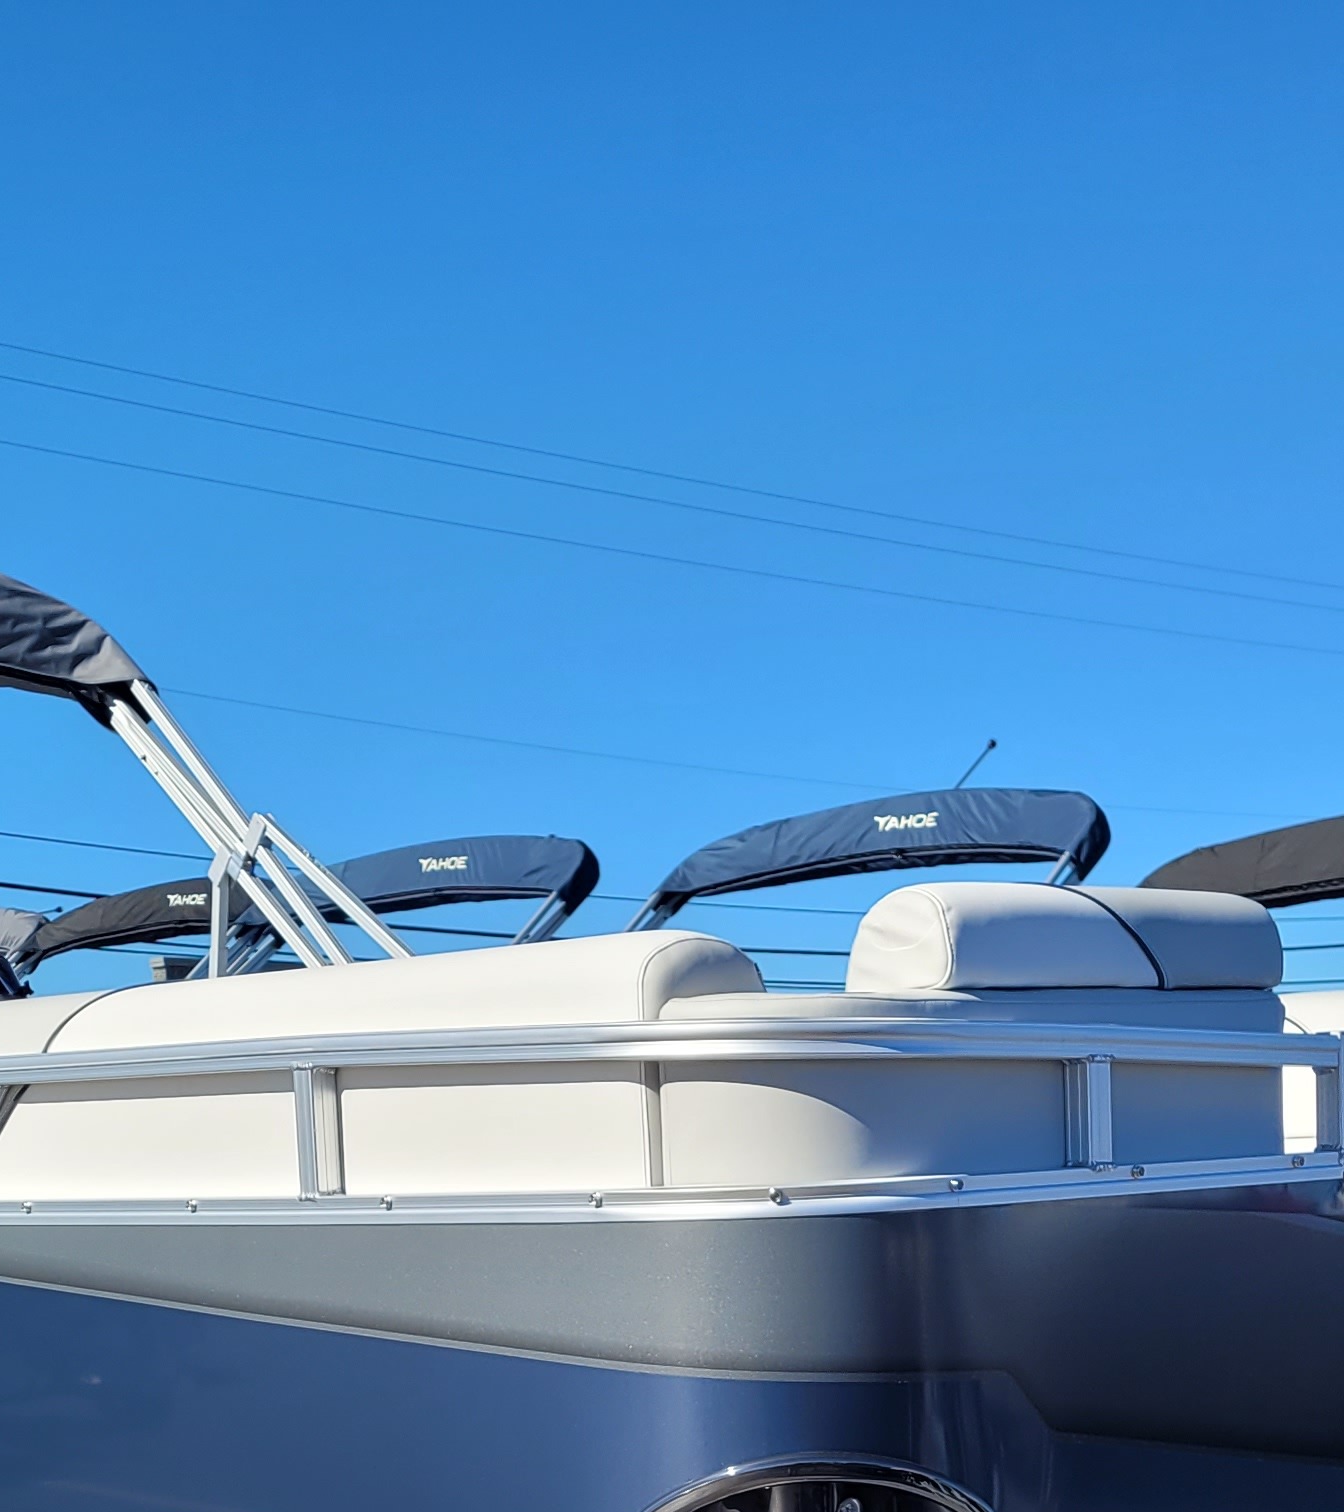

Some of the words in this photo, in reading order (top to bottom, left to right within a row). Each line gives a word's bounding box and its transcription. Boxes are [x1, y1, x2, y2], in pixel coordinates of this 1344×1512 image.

[873, 811, 940, 833] TAHOE
[418, 855, 469, 874] TAHOE
[166, 893, 208, 907] TAHOE
